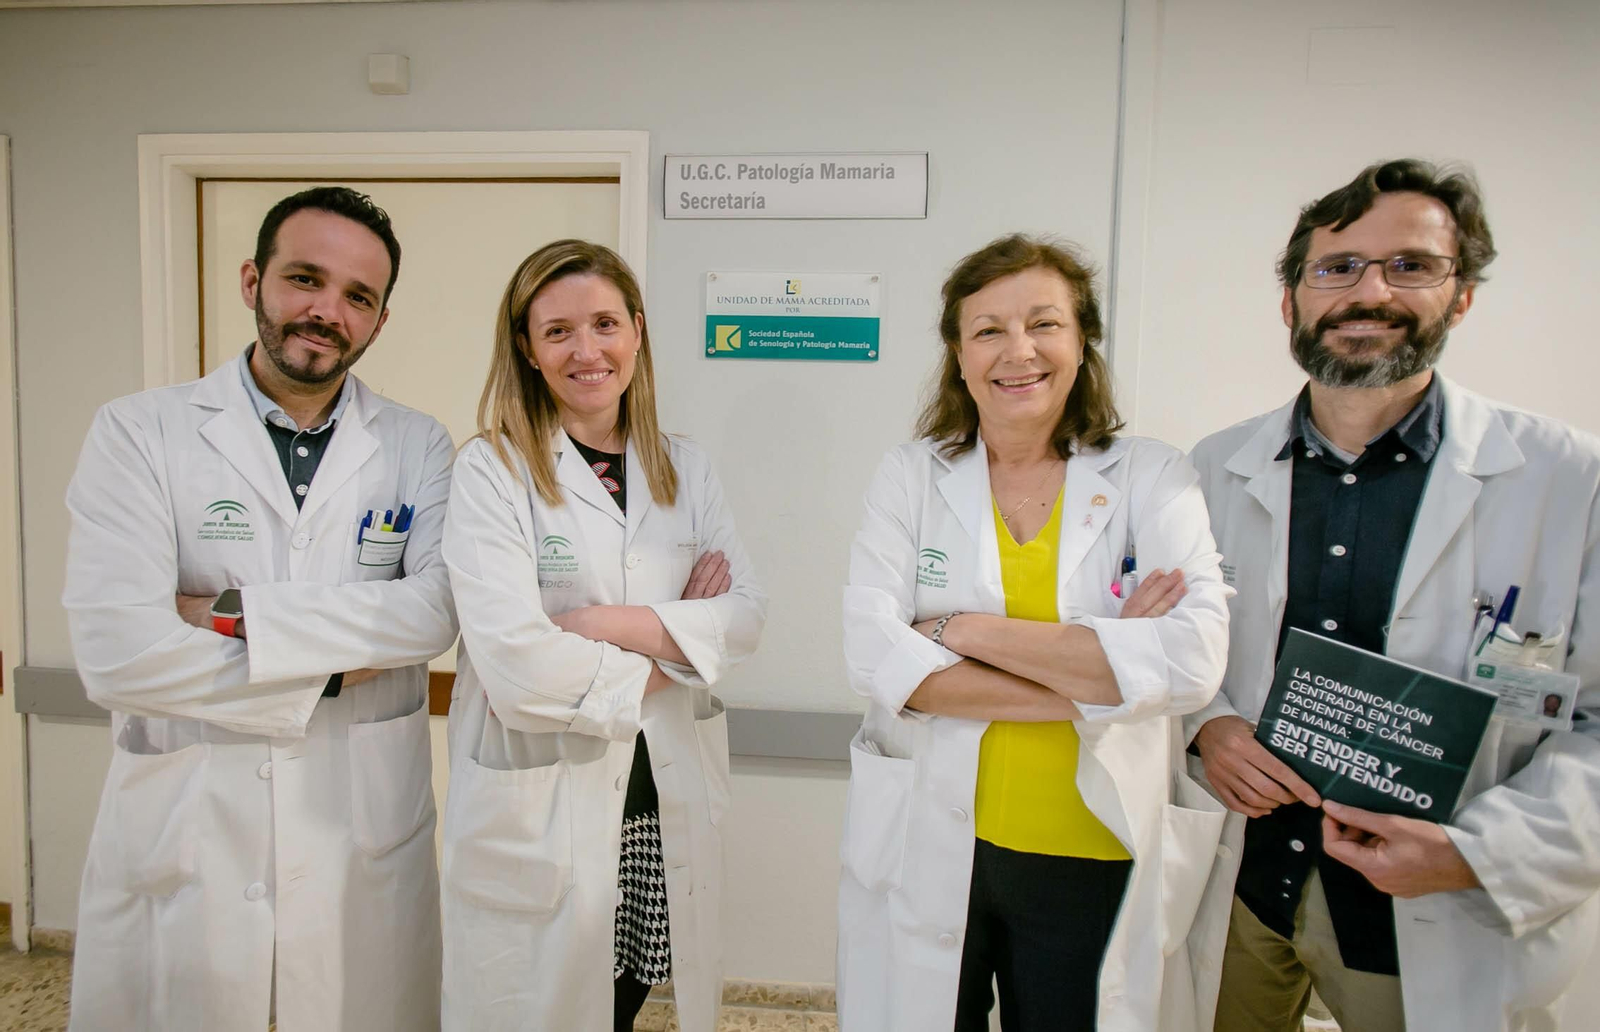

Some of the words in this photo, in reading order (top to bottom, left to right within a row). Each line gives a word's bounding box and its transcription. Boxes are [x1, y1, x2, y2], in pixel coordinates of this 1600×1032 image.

[680, 164, 731, 180] U.G.C.
[737, 163, 814, 184] Patología
[820, 162, 895, 180] Mamaria
[680, 191, 766, 210] Secretaría
[717, 296, 758, 304] UNIDAD
[760, 297, 774, 305] DE
[776, 297, 806, 305] MAMA
[808, 297, 870, 306] ACREDITADA
[748, 330, 781, 338] Sociedad
[782, 330, 814, 339] Española
[759, 340, 795, 348] Senología
[802, 340, 836, 350] Patología
[838, 341, 870, 349] Mamaria
[540, 580, 573, 588] EDICO
[1289, 679, 1364, 715] CENTRADA
[1367, 709, 1390, 724] EN
[1392, 717, 1412, 734] LA
[1293, 667, 1312, 682] LA
[1314, 675, 1433, 726] COMUNICACIÓN
[1281, 703, 1300, 719] DE
[1301, 712, 1351, 739] MAMA:
[1285, 691, 1354, 725] PACIENTE
[1355, 718, 1377, 734] DE
[1379, 727, 1444, 760] CÁNCER
[1274, 718, 1381, 772] ENTENDER
[1384, 762, 1402, 779] Y
[1270, 733, 1308, 759] SER
[1310, 750, 1433, 809] ENTENDIDO
